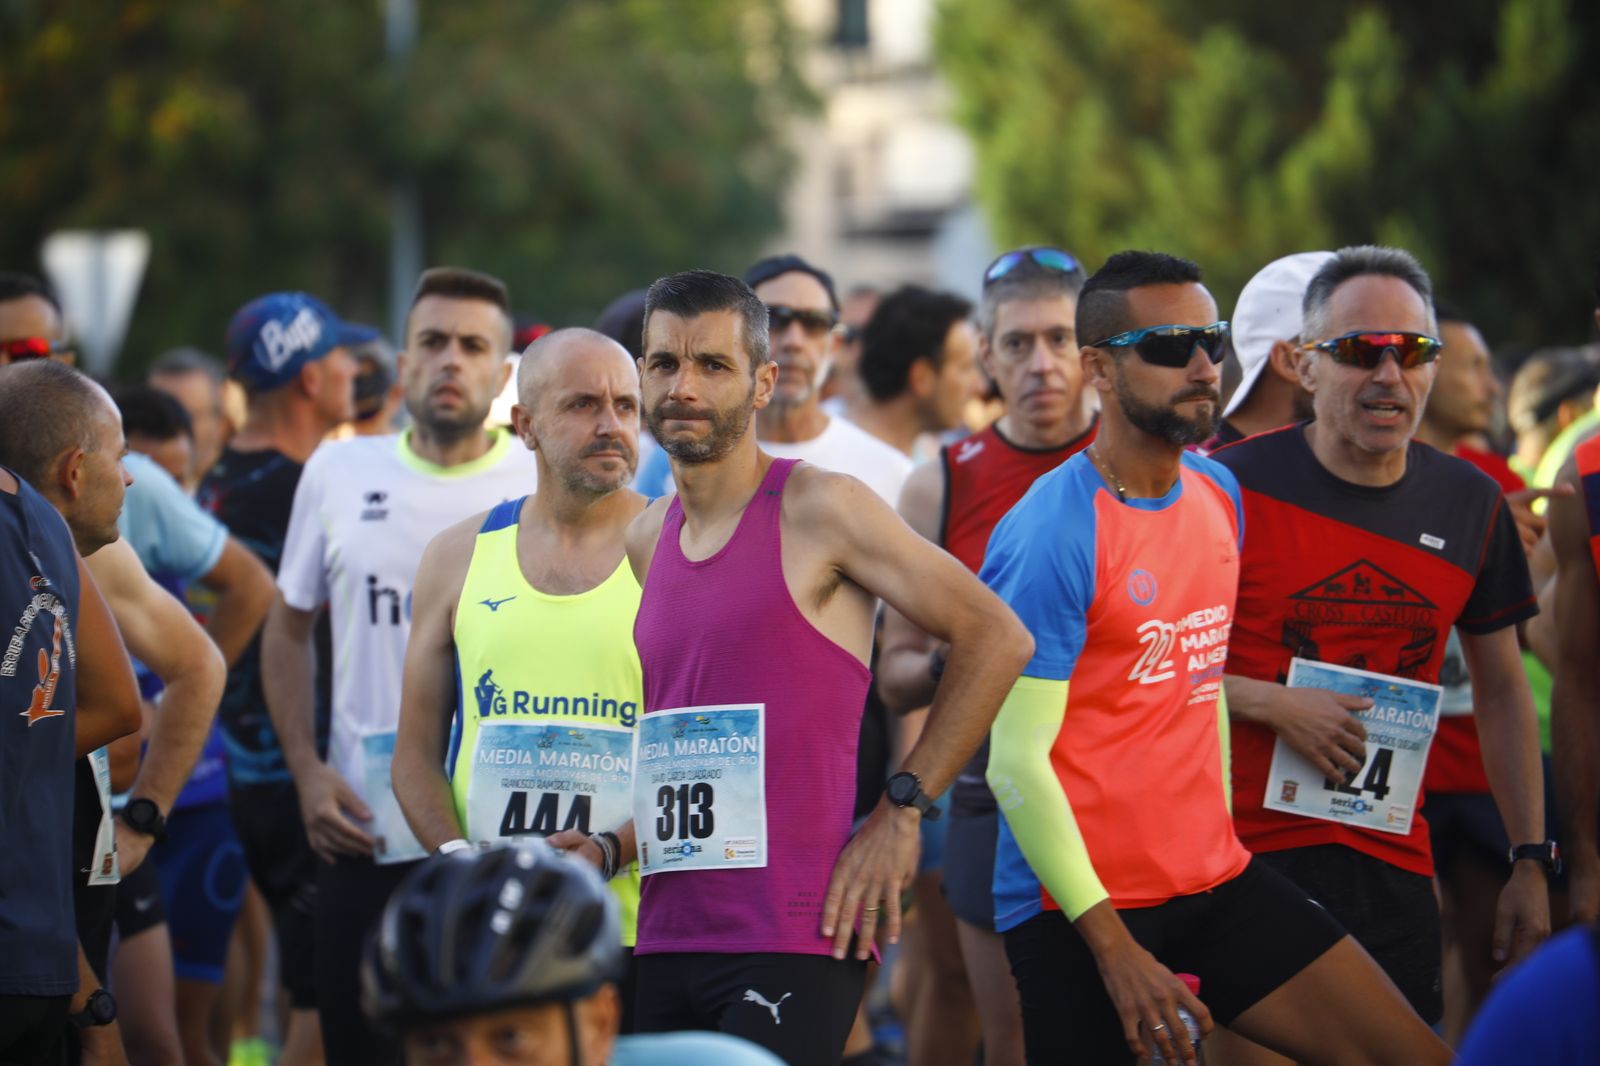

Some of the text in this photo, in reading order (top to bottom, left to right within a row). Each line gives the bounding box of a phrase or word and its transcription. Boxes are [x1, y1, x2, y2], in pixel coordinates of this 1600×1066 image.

[367, 574, 413, 625] in
[1295, 602, 1344, 621] CROSS
[513, 690, 637, 727] Running
[479, 748, 630, 772] MEDIA MARATÓN
[640, 732, 757, 760] MEDIA MARATÓN
[656, 782, 714, 841] 313
